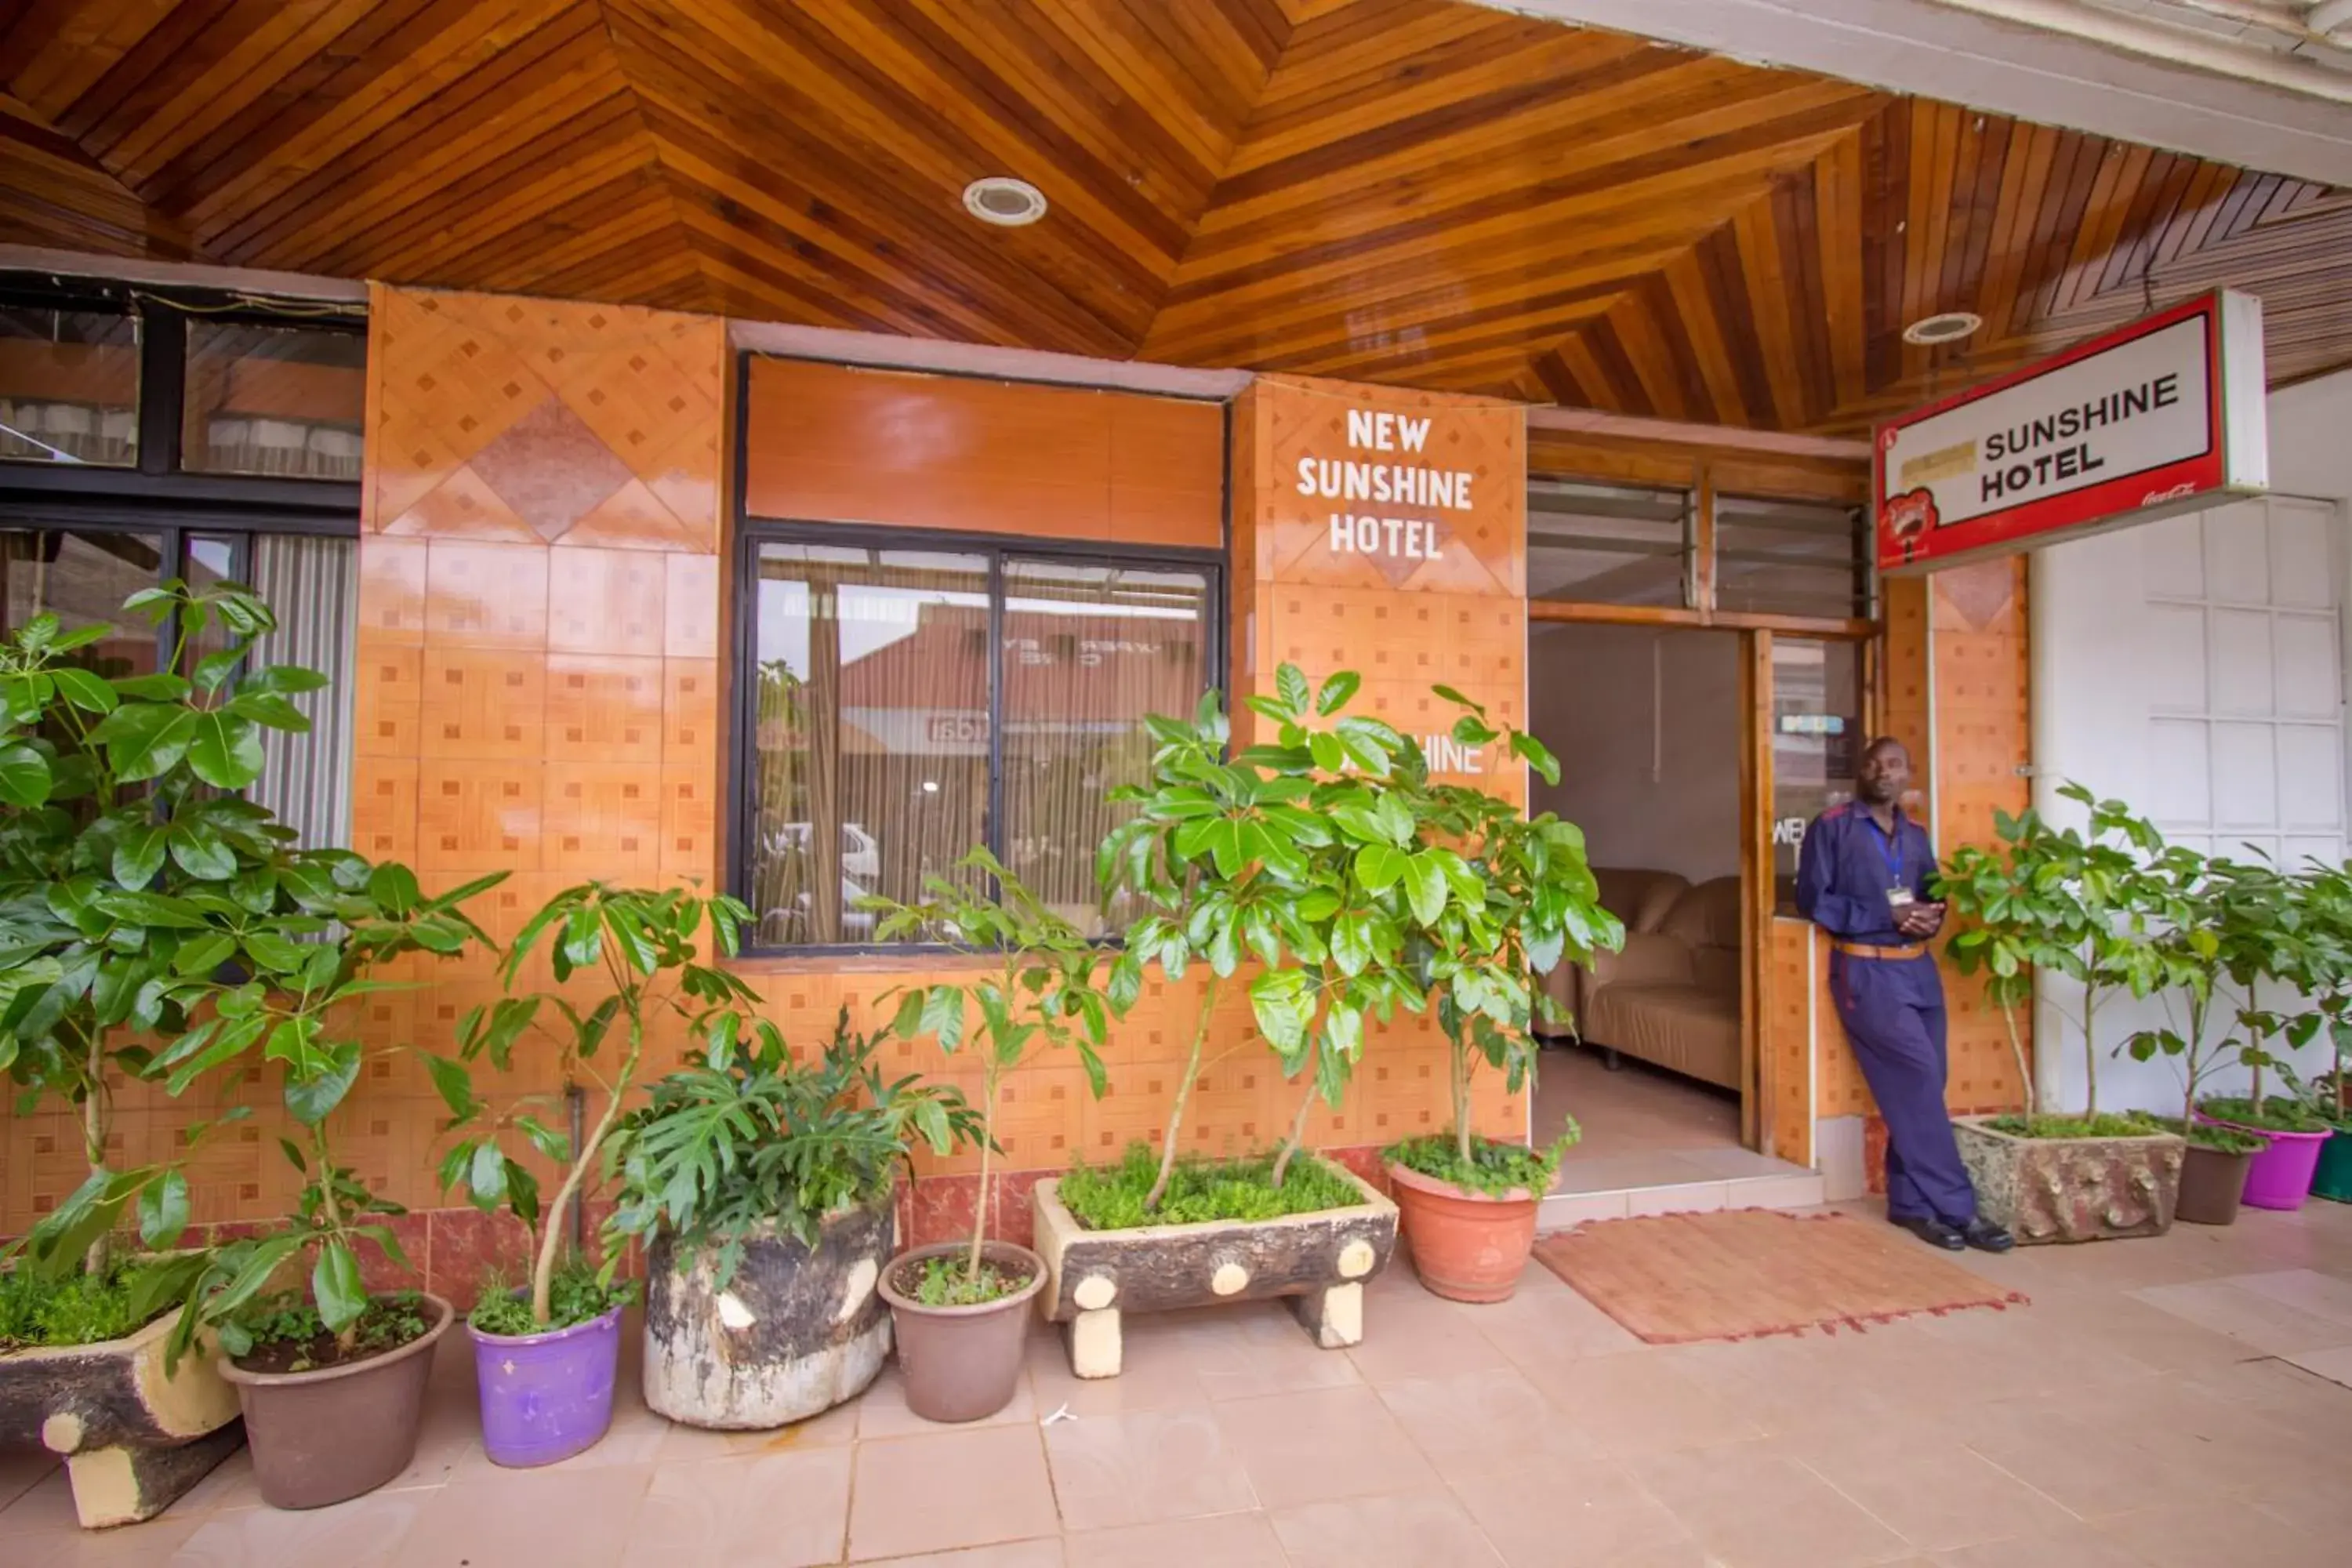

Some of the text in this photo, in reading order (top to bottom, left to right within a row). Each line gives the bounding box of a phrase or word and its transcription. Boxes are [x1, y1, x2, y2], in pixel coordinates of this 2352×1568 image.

[1348, 408, 1432, 453] NEW
[1985, 372, 2179, 462] SUNSHINE
[1296, 457, 1473, 510] SUNSHINE
[1981, 441, 2104, 503] HOTEL
[1330, 514, 1443, 560] HOTEL
